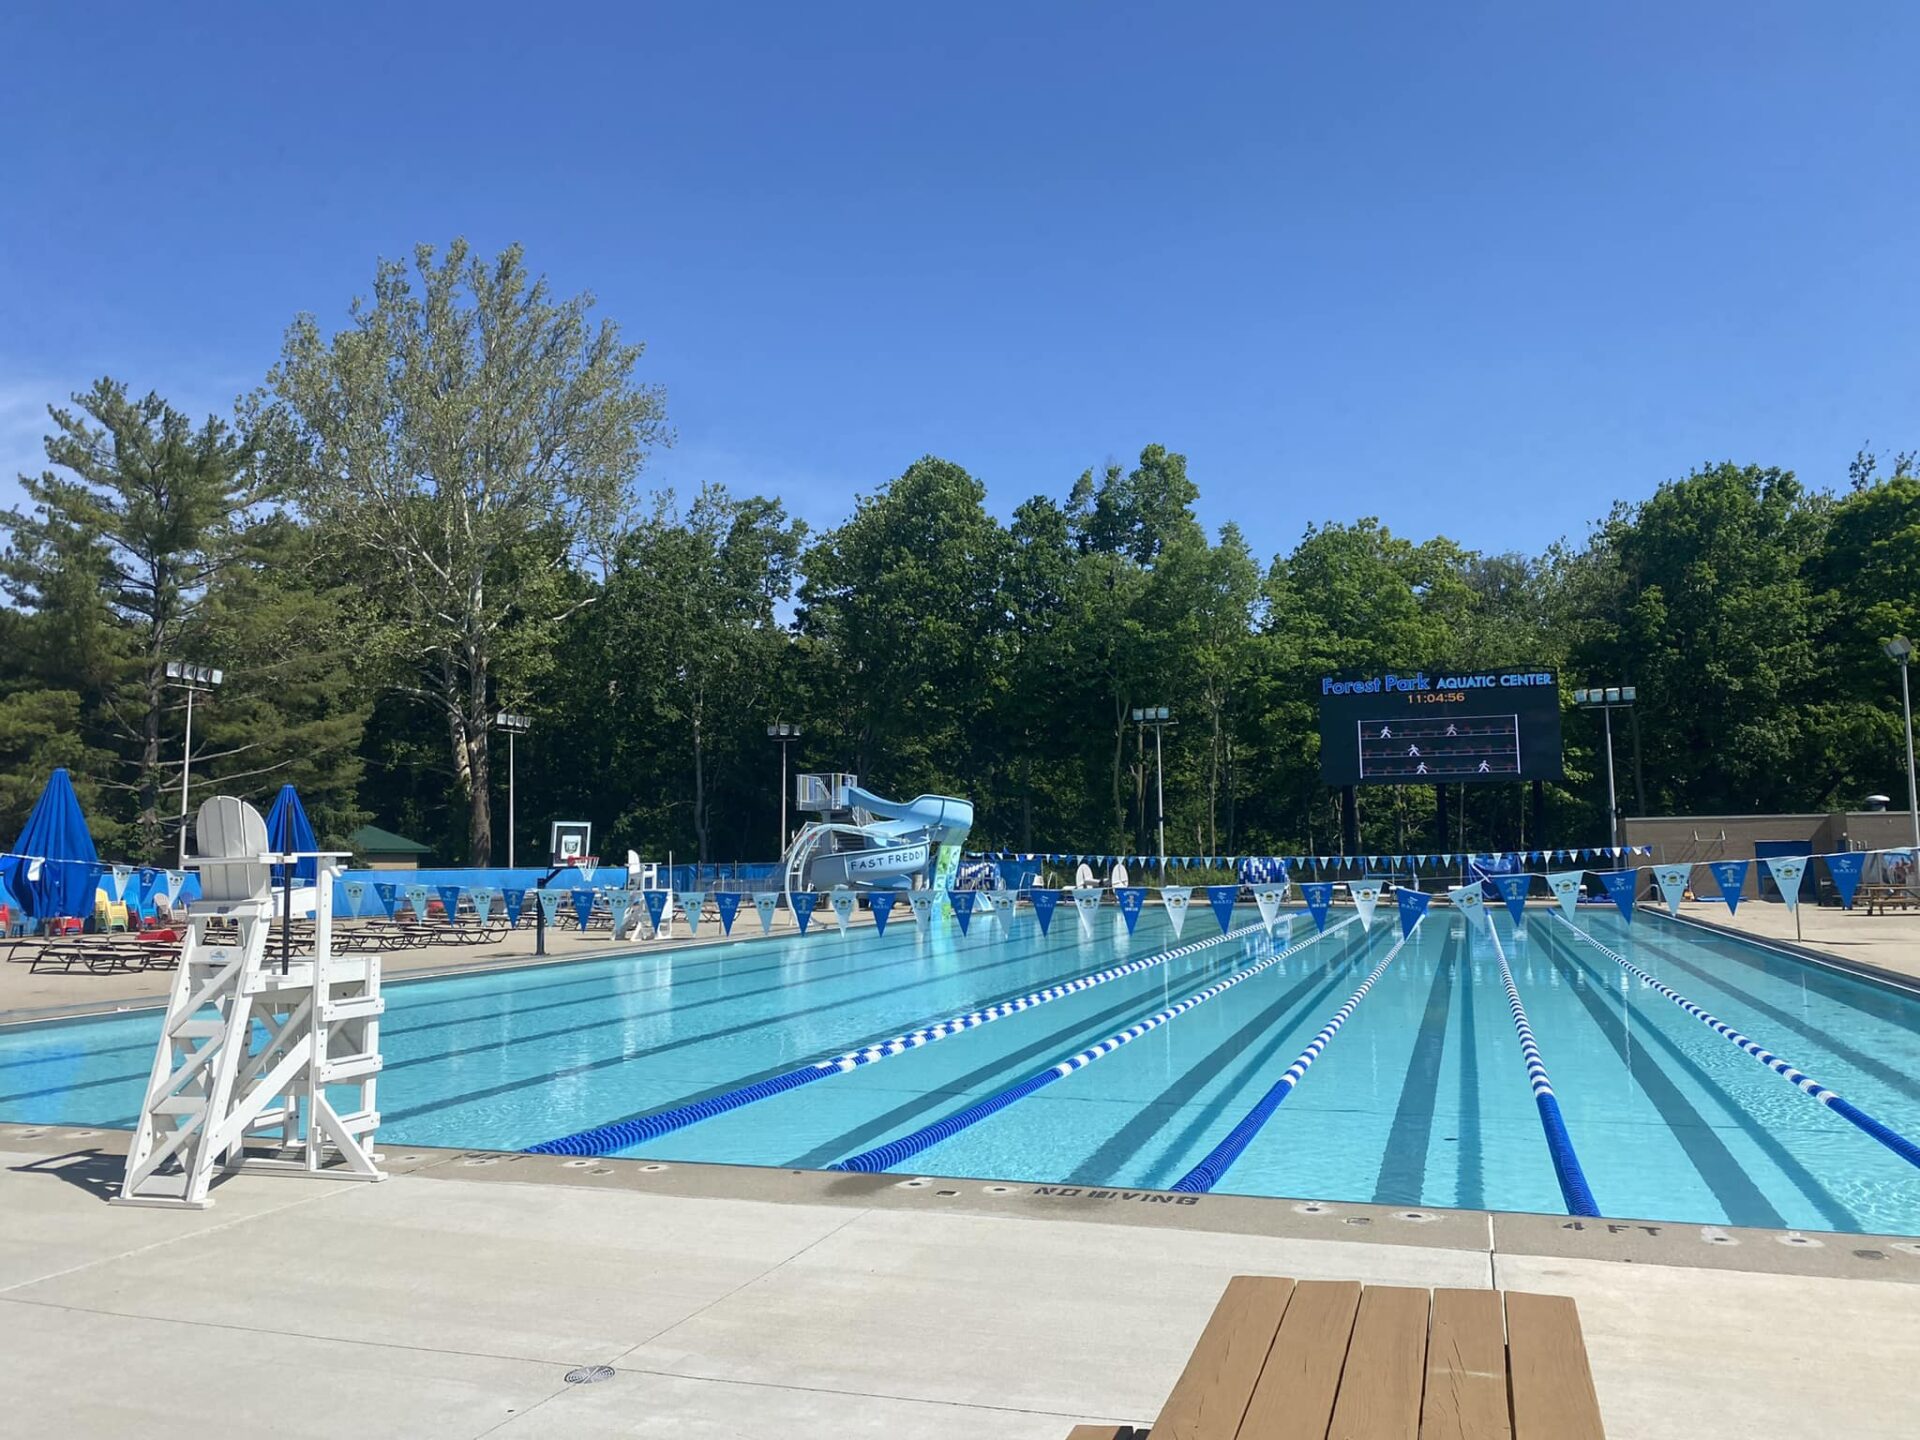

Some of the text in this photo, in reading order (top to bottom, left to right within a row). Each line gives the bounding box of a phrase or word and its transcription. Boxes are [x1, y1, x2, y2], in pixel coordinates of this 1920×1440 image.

[1322, 672, 1552, 695] Forest Park AQUATIC CENTER
[1408, 692, 1465, 704] 11:04:56
[850, 858, 884, 871] FAST
[1034, 1187, 1082, 1197] NO
[1562, 1222, 1662, 1236] 4 FT
